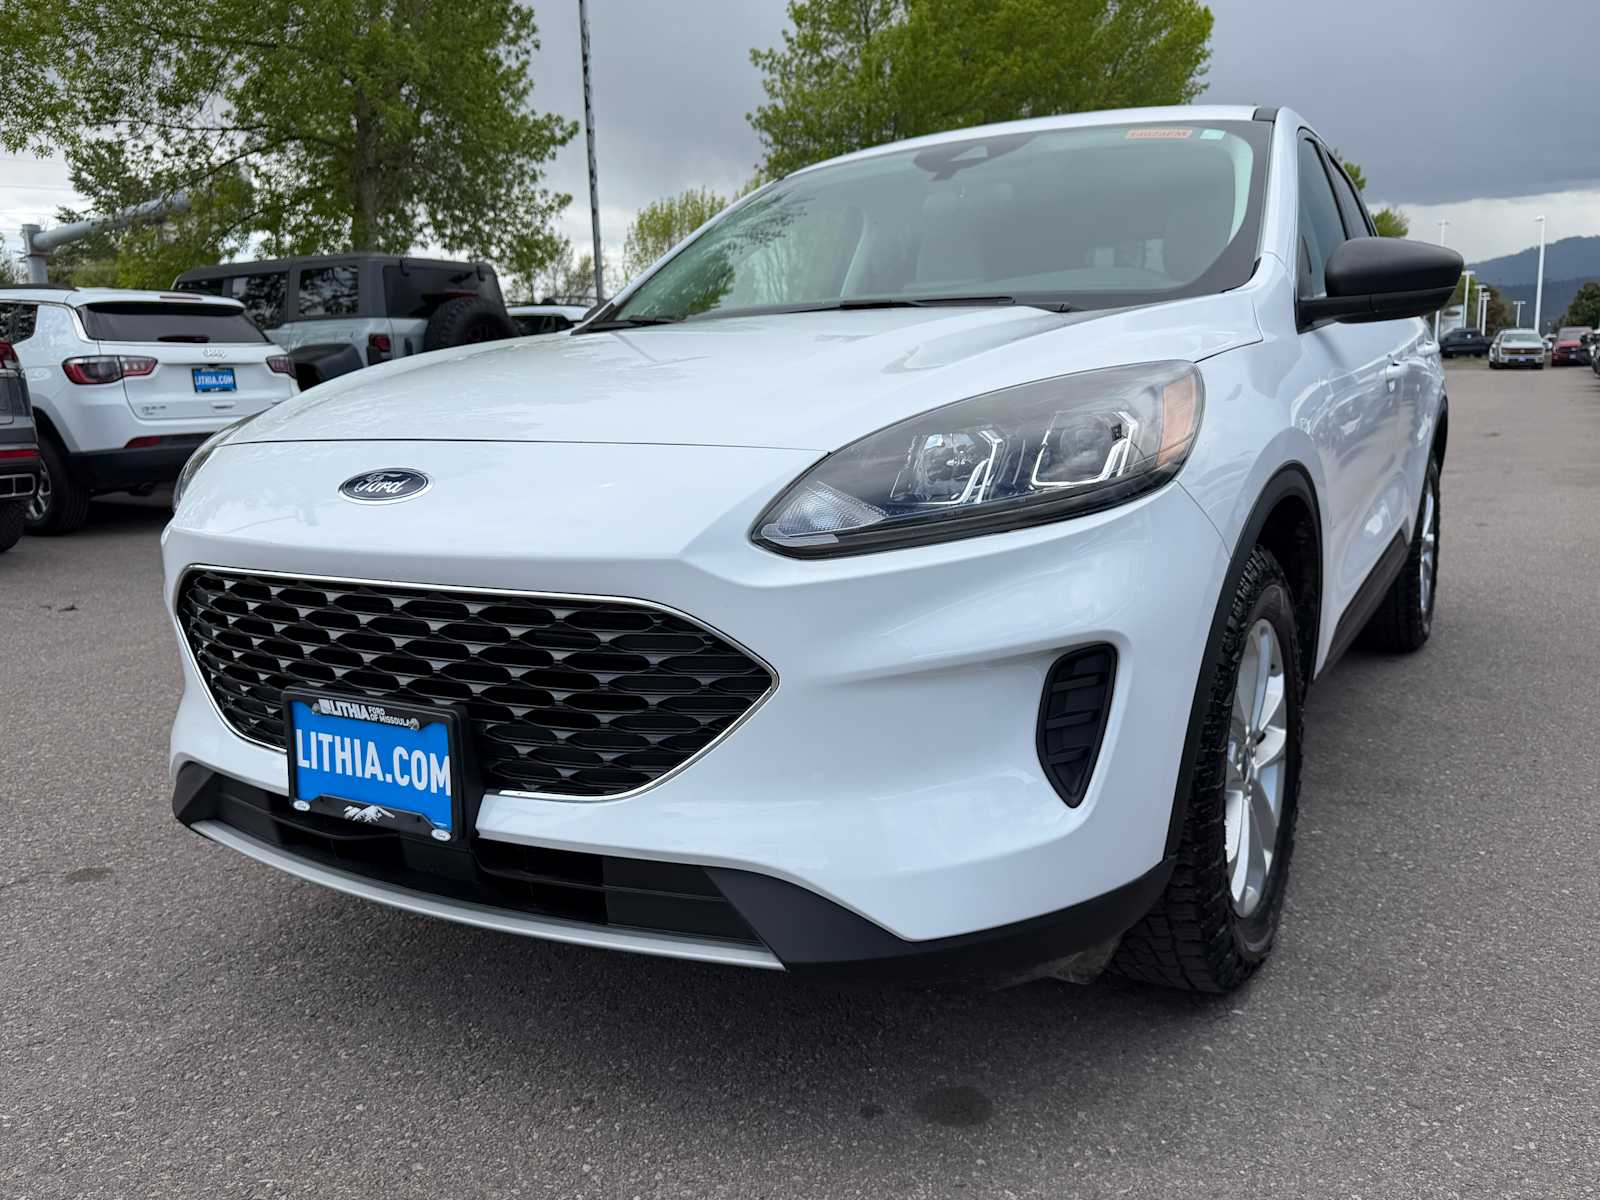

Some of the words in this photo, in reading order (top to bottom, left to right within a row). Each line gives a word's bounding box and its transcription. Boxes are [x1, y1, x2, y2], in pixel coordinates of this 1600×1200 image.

[195, 375, 233, 385] LITHIA.COM
[353, 473, 411, 493] Ford
[329, 700, 371, 720] LITHIA
[296, 729, 451, 796] LITHIA.COM
